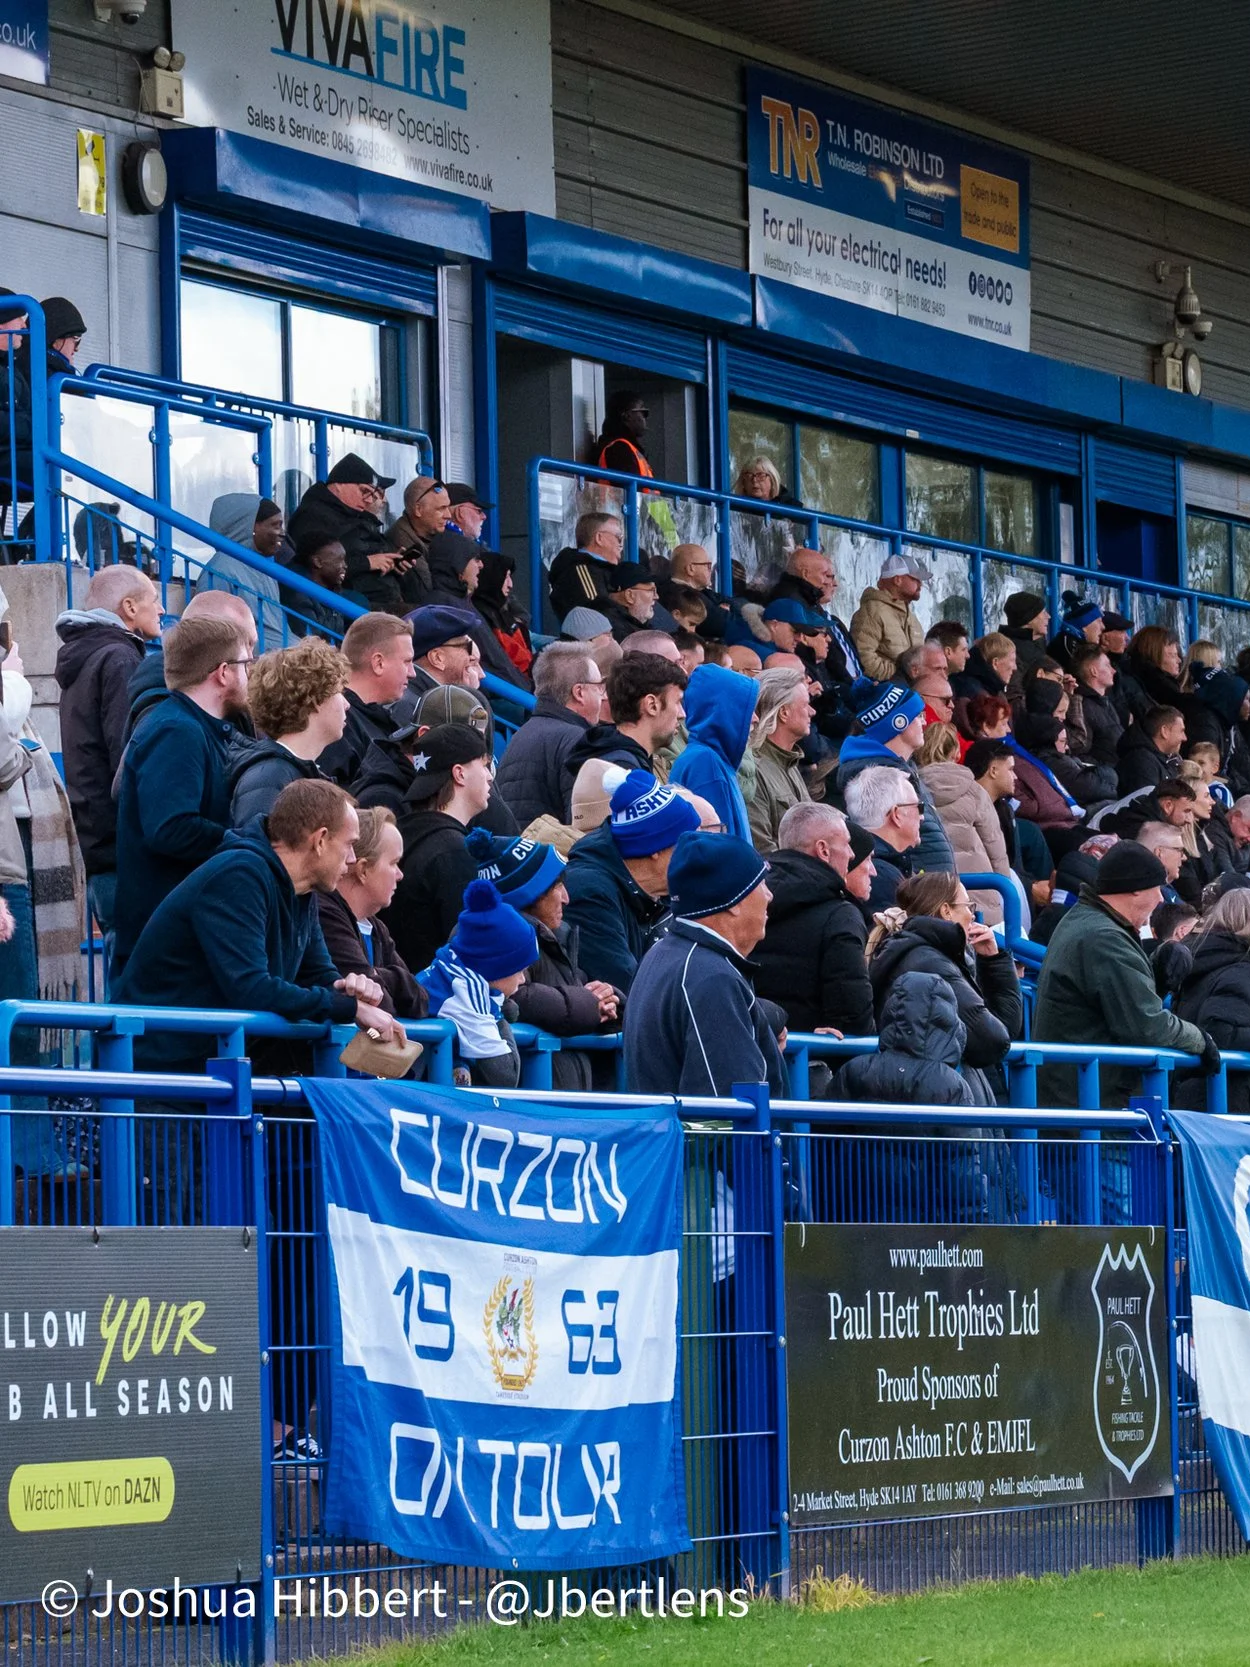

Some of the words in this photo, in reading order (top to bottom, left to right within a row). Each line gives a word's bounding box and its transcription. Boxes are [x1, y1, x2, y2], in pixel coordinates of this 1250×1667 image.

[0, 22, 37, 50] o.uk
[275, 0, 467, 110] VIVAFIRE
[277, 72, 309, 109] Wet
[313, 83, 324, 113] &
[328, 88, 353, 126] Dry
[358, 96, 393, 131] Riser
[397, 108, 471, 155] Specialists
[247, 105, 275, 132] Sales
[278, 116, 286, 134] &
[289, 118, 330, 148] Service:
[332, 130, 355, 154] 0845
[403, 153, 494, 192] www.vivafire.co.uk
[761, 95, 823, 189] TNR
[826, 119, 850, 149] T.N.
[854, 128, 920, 172] ROBINSON
[923, 151, 945, 179] LTD
[827, 151, 867, 178] Wholesale
[970, 181, 989, 201] Open
[982, 216, 995, 231] and
[762, 208, 783, 240] For
[787, 216, 803, 247] all
[808, 226, 837, 257] your
[841, 232, 901, 276] electrical
[905, 255, 947, 290] needs!
[860, 686, 905, 726] CURZON
[389, 1108, 628, 1225] CURZON
[889, 1240, 984, 1275] www.paulhett.com
[393, 1266, 455, 1362] 19
[828, 1291, 872, 1341] Paul
[877, 1290, 920, 1340] Hett
[925, 1289, 1004, 1351] Trophies
[1008, 1287, 1040, 1336] Ltd
[1107, 1297, 1124, 1315] PAUL
[1125, 1296, 1142, 1315] HETT
[3, 1310, 87, 1348] LLOW
[95, 1294, 217, 1386] YOUR
[561, 1289, 622, 1375] 63
[8, 1384, 22, 1421] B
[43, 1381, 97, 1420] ALL
[117, 1376, 234, 1416] SEASON
[877, 1366, 918, 1403] Proud
[922, 1364, 981, 1410] Sponsors
[985, 1362, 1000, 1399] of
[838, 1428, 890, 1464] Curzon
[894, 1424, 942, 1460] Ashton
[944, 1421, 968, 1458] F.C
[970, 1421, 984, 1456] &
[987, 1418, 1036, 1455] EMJFL
[1111, 1411, 1129, 1425] FISHING
[1129, 1410, 1144, 1424] TACKLE
[22, 1484, 64, 1512] Watch
[67, 1478, 102, 1509] NLTV
[104, 1484, 121, 1507] on
[124, 1476, 162, 1505] DAZN
[792, 1494, 806, 1512] 2-4
[806, 1491, 833, 1512] Market
[834, 1489, 858, 1511] Street,
[859, 1488, 879, 1512] Hyde
[880, 1486, 900, 1505] SK14
[902, 1484, 917, 1504] 1AY
[922, 1484, 936, 1502] Tel:
[936, 1482, 952, 1501] 0161
[954, 1480, 967, 1500] 368
[989, 1477, 1015, 1497] e-Mail:
[1016, 1472, 1085, 1498] sales@paulhett.co.uk
